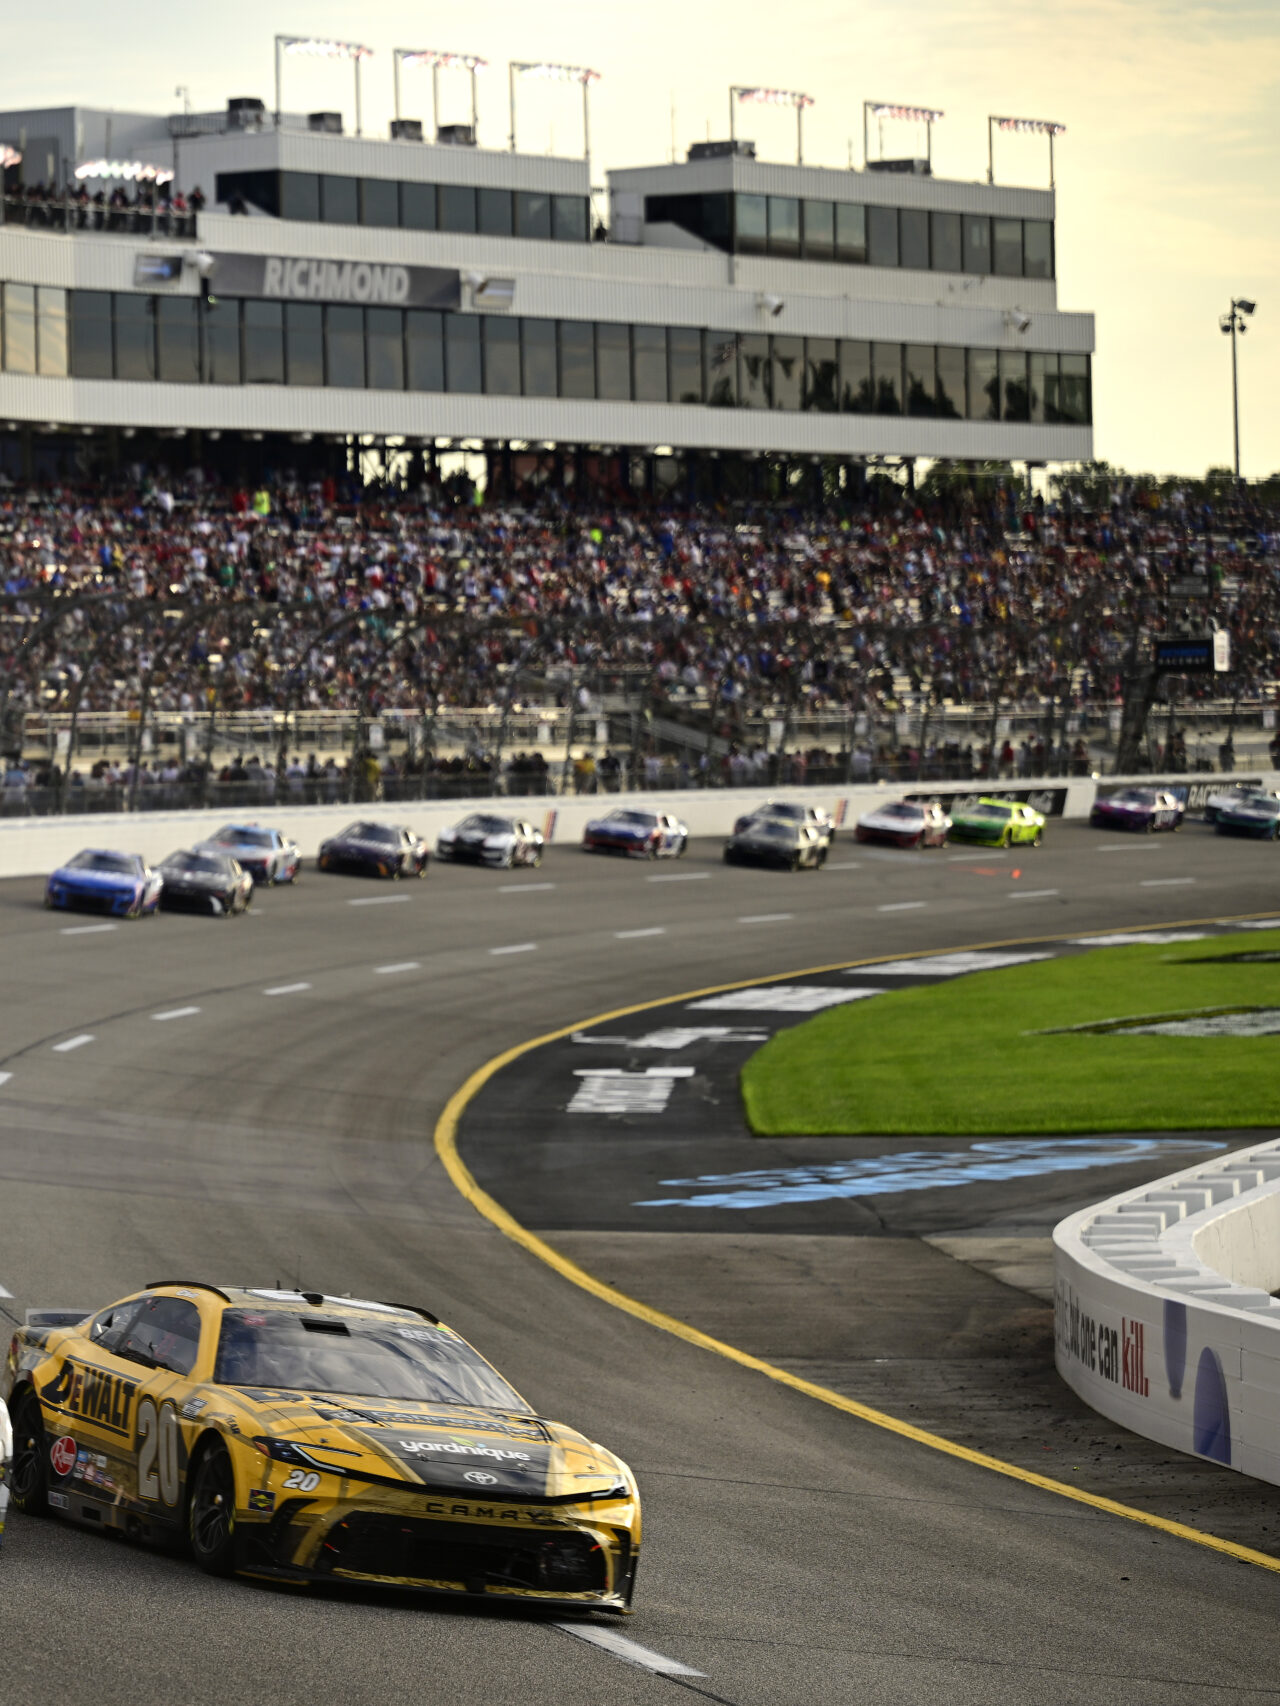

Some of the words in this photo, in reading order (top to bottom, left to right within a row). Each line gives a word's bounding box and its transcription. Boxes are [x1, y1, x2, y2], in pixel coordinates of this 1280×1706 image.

[262, 256, 411, 301] RICHMOND
[398, 1328, 455, 1344] BELL
[1081, 1312, 1096, 1372] one
[1098, 1323, 1119, 1384] can
[1122, 1316, 1149, 1397] kill.
[137, 1394, 180, 1507] 20
[398, 1439, 531, 1461] yardnique
[282, 1469, 321, 1492] 20
[426, 1502, 553, 1524] CAMRY
